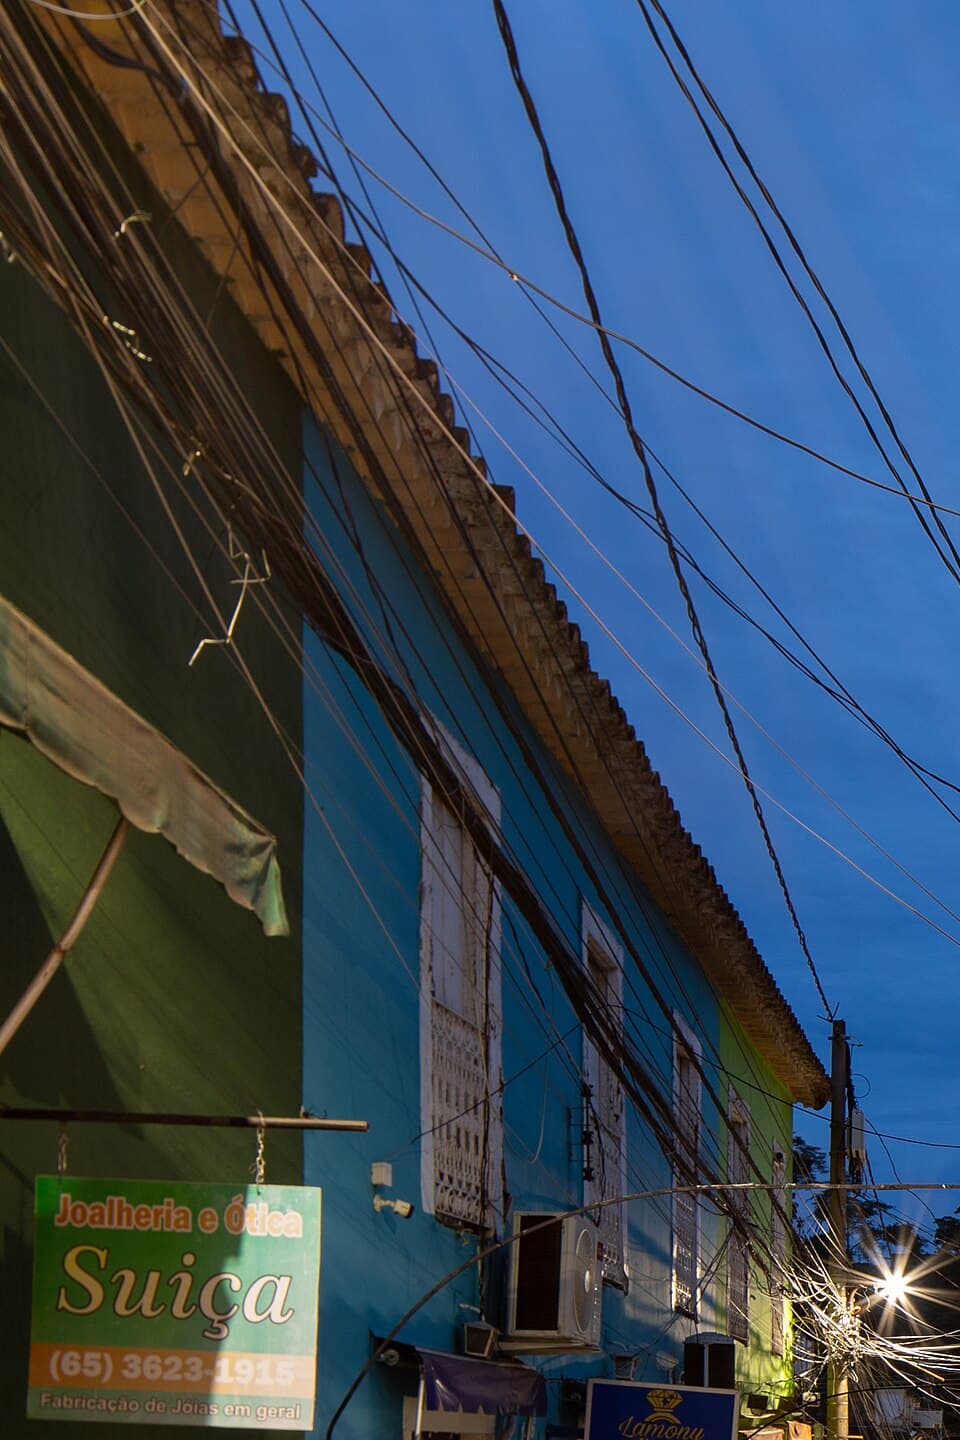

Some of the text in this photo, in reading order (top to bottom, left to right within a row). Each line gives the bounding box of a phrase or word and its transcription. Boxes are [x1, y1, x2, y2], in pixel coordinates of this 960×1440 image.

[55, 1193, 303, 1238] Joalheria e Ótica
[57, 1243, 294, 1340] Suiça
[49, 1350, 295, 1386] (65) 3623-1915
[40, 1393, 140, 1414] Fabricação
[145, 1396, 165, 1412] de
[224, 1403, 250, 1418] em
[256, 1404, 301, 1420] geral
